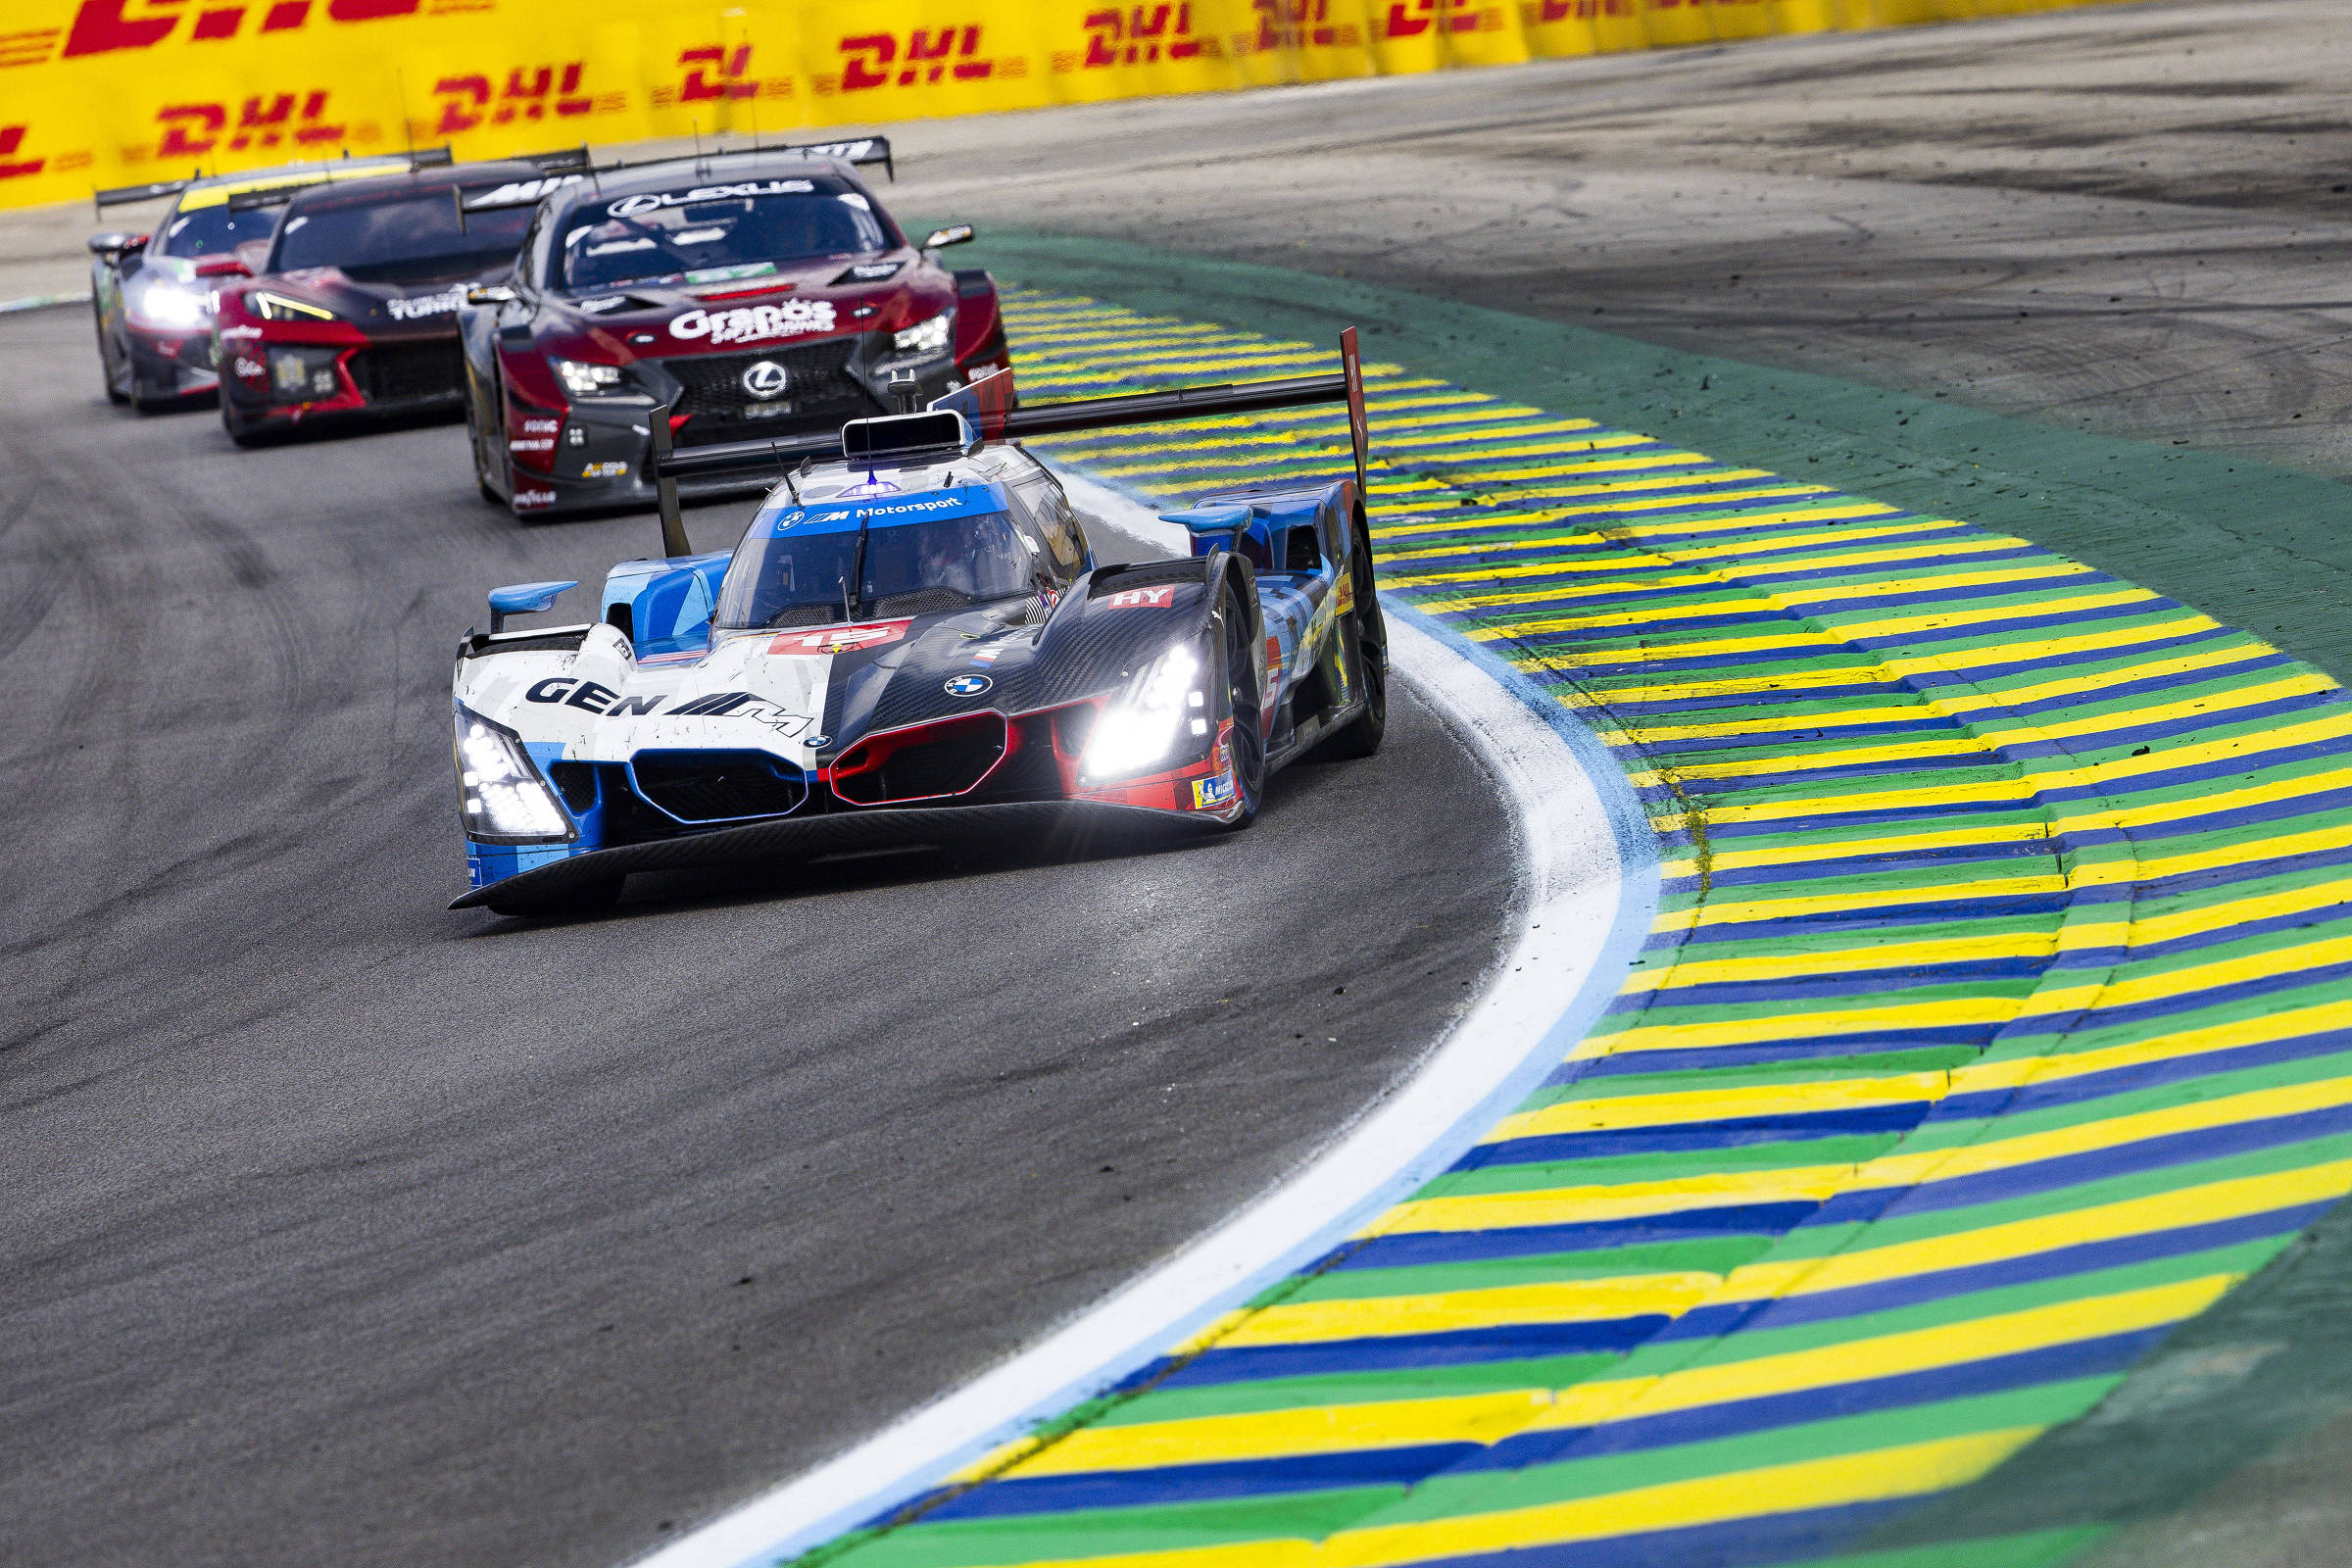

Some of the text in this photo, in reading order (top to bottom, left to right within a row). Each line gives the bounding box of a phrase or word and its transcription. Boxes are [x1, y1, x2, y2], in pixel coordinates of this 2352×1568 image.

[1083, 4, 1201, 70] DHL
[838, 24, 993, 92] DHL
[432, 61, 592, 135] DHL
[156, 90, 346, 158] DHL
[662, 178, 814, 206] LEXUS
[856, 497, 962, 518] Motorsport
[1112, 588, 1171, 607] HY
[793, 627, 891, 648] 15
[524, 677, 668, 716] GEN
